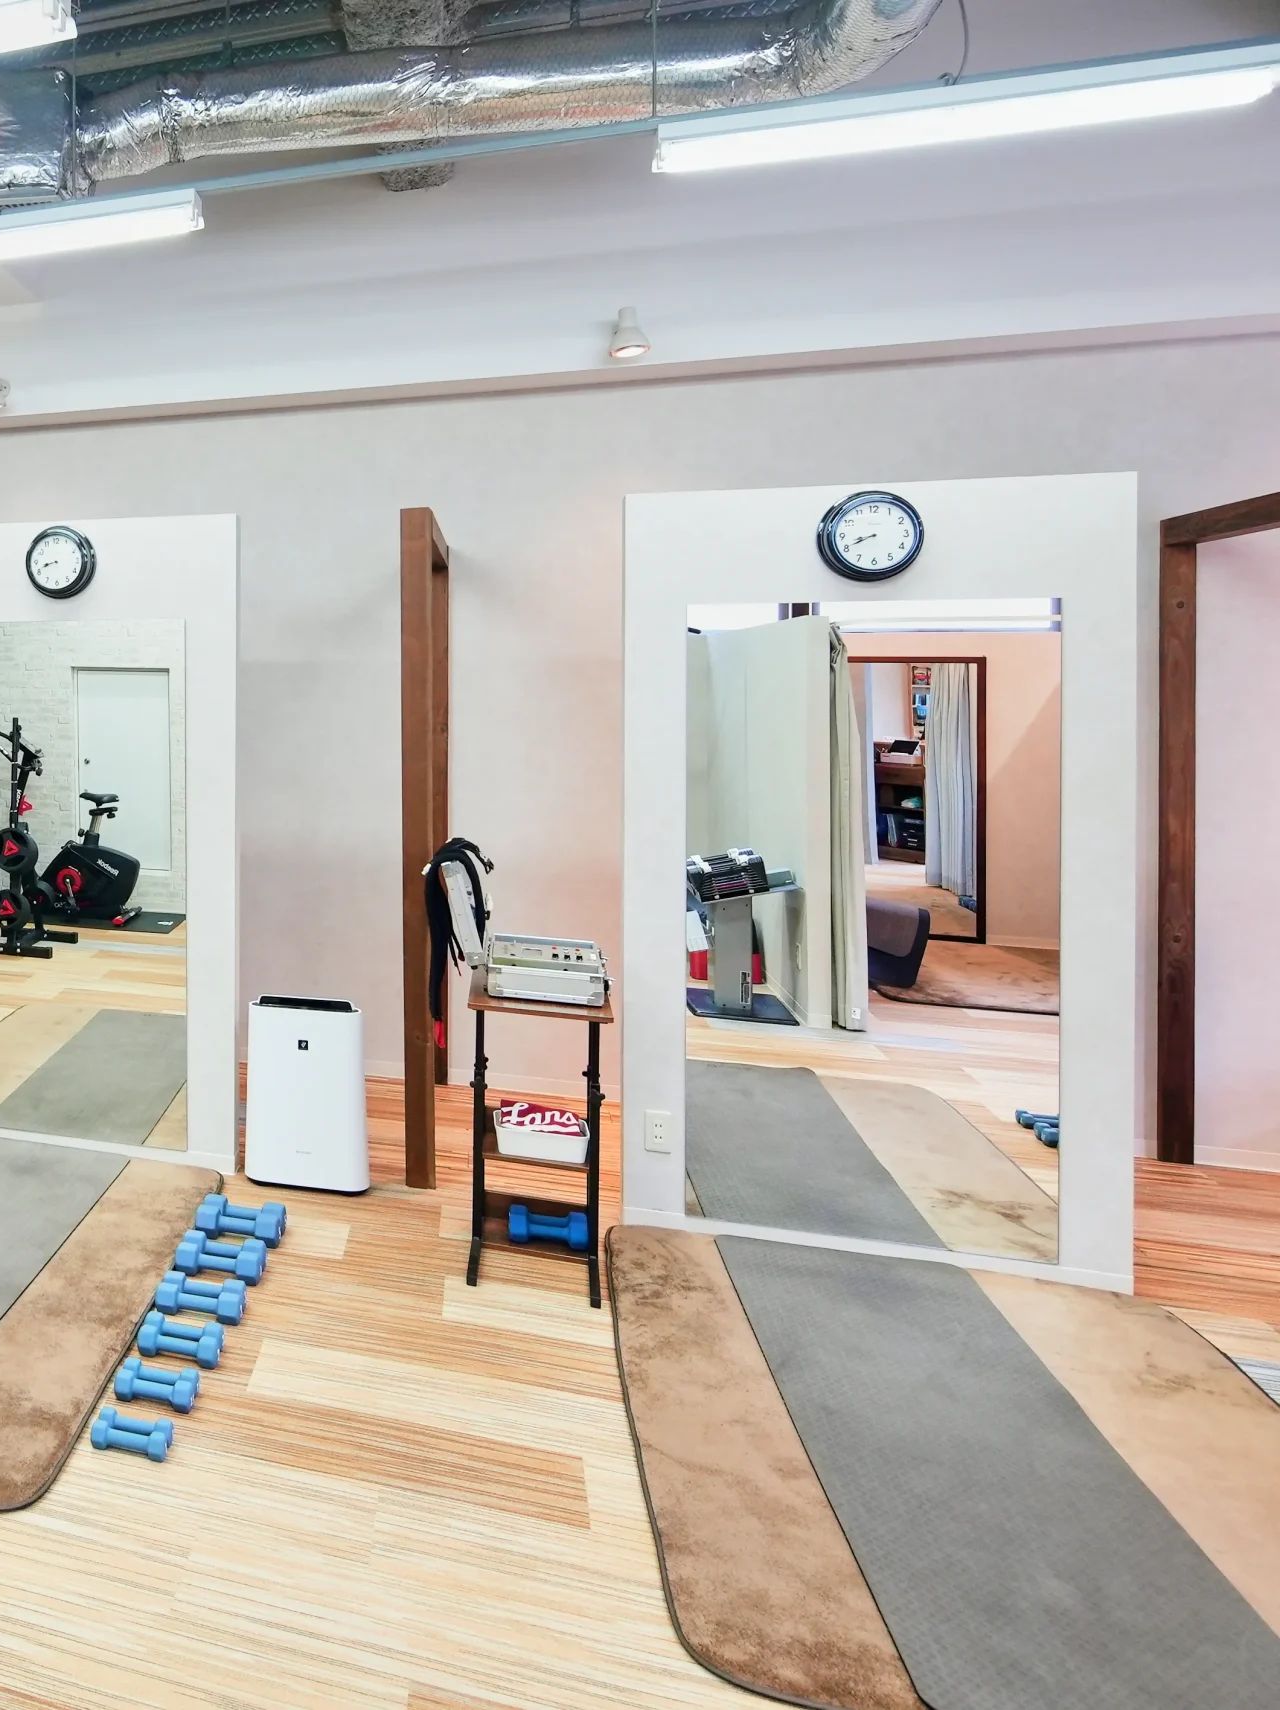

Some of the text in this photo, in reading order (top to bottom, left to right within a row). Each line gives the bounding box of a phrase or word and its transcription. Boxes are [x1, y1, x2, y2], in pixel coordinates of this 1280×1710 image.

[869, 505, 879, 514] 12
[898, 516, 905, 525] 2
[839, 532, 846, 541] 9
[903, 529, 910, 538] 3
[53, 537, 60, 545] 12
[843, 544, 850, 553] 8
[898, 542, 905, 550] 4
[856, 554, 862, 563] 7
[871, 557, 878, 566] 6
[887, 553, 894, 561] 5
